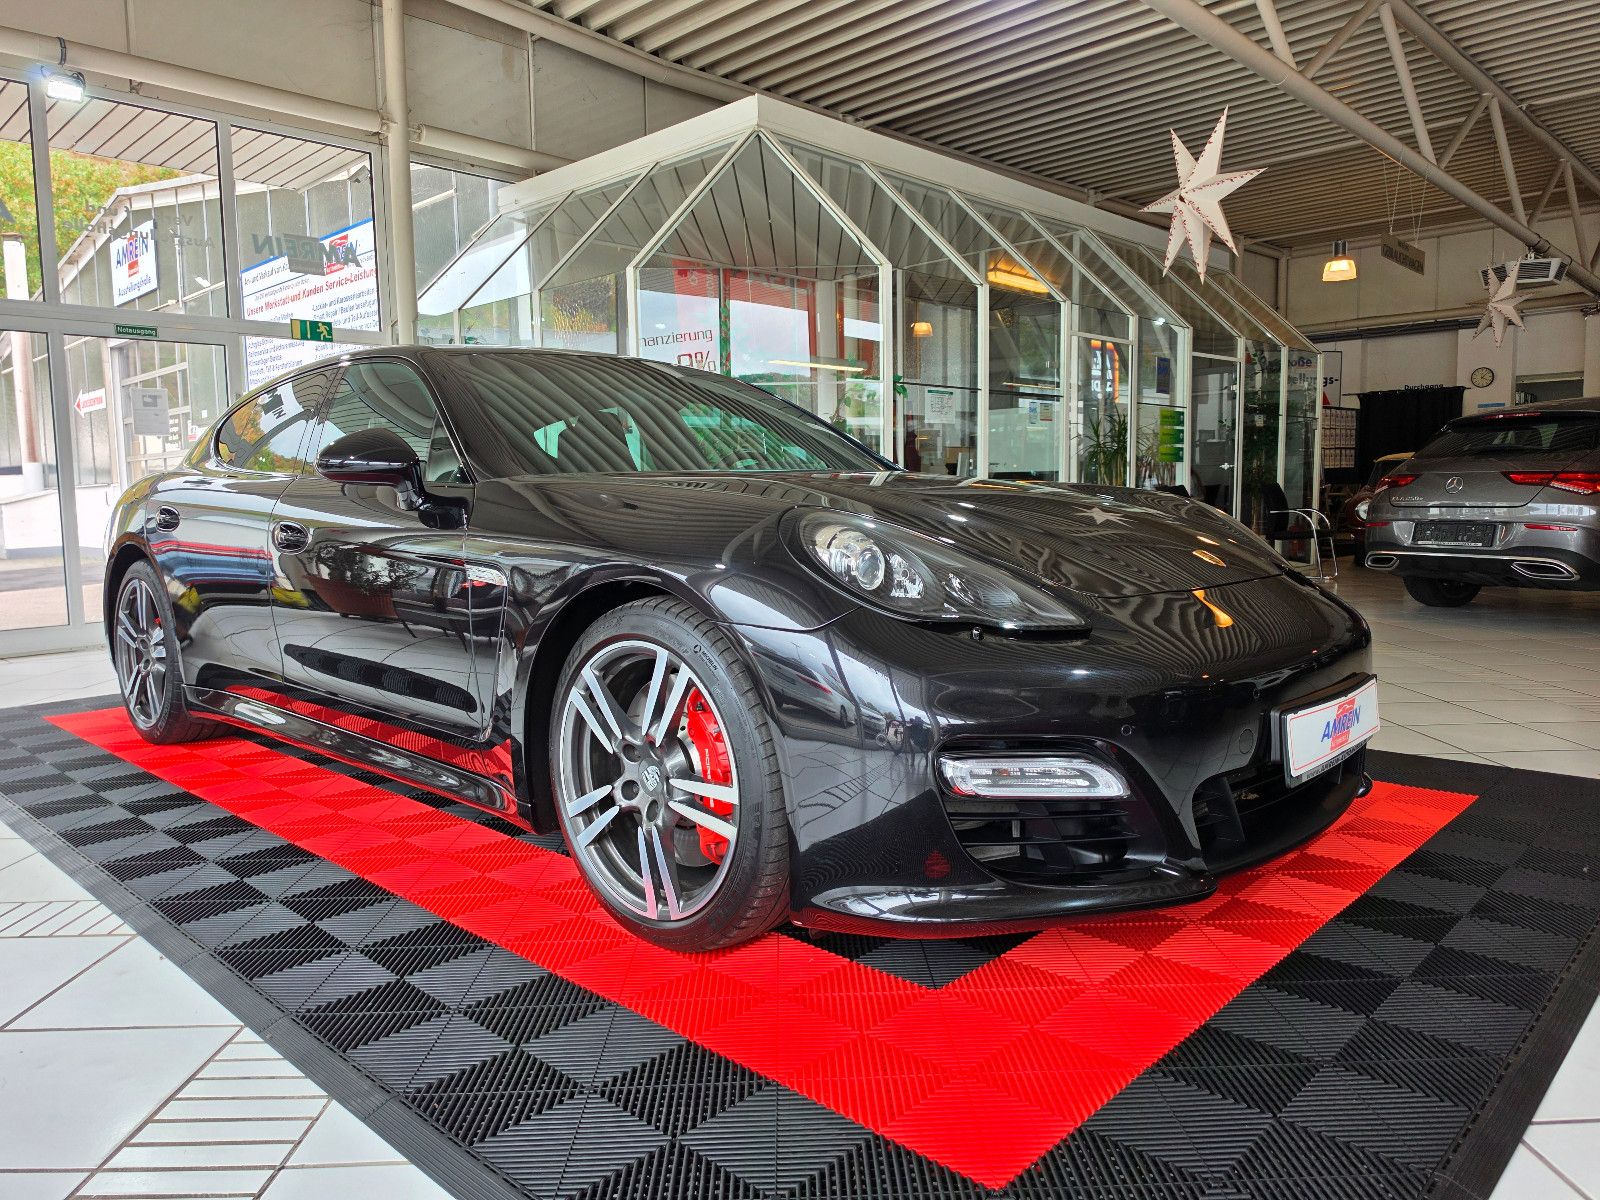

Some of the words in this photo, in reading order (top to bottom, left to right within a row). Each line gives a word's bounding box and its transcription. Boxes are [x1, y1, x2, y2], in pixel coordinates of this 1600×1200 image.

[116, 236, 149, 269] AMREIN
[117, 325, 157, 336] Notausgang
[1320, 705, 1362, 743] AMREIN
